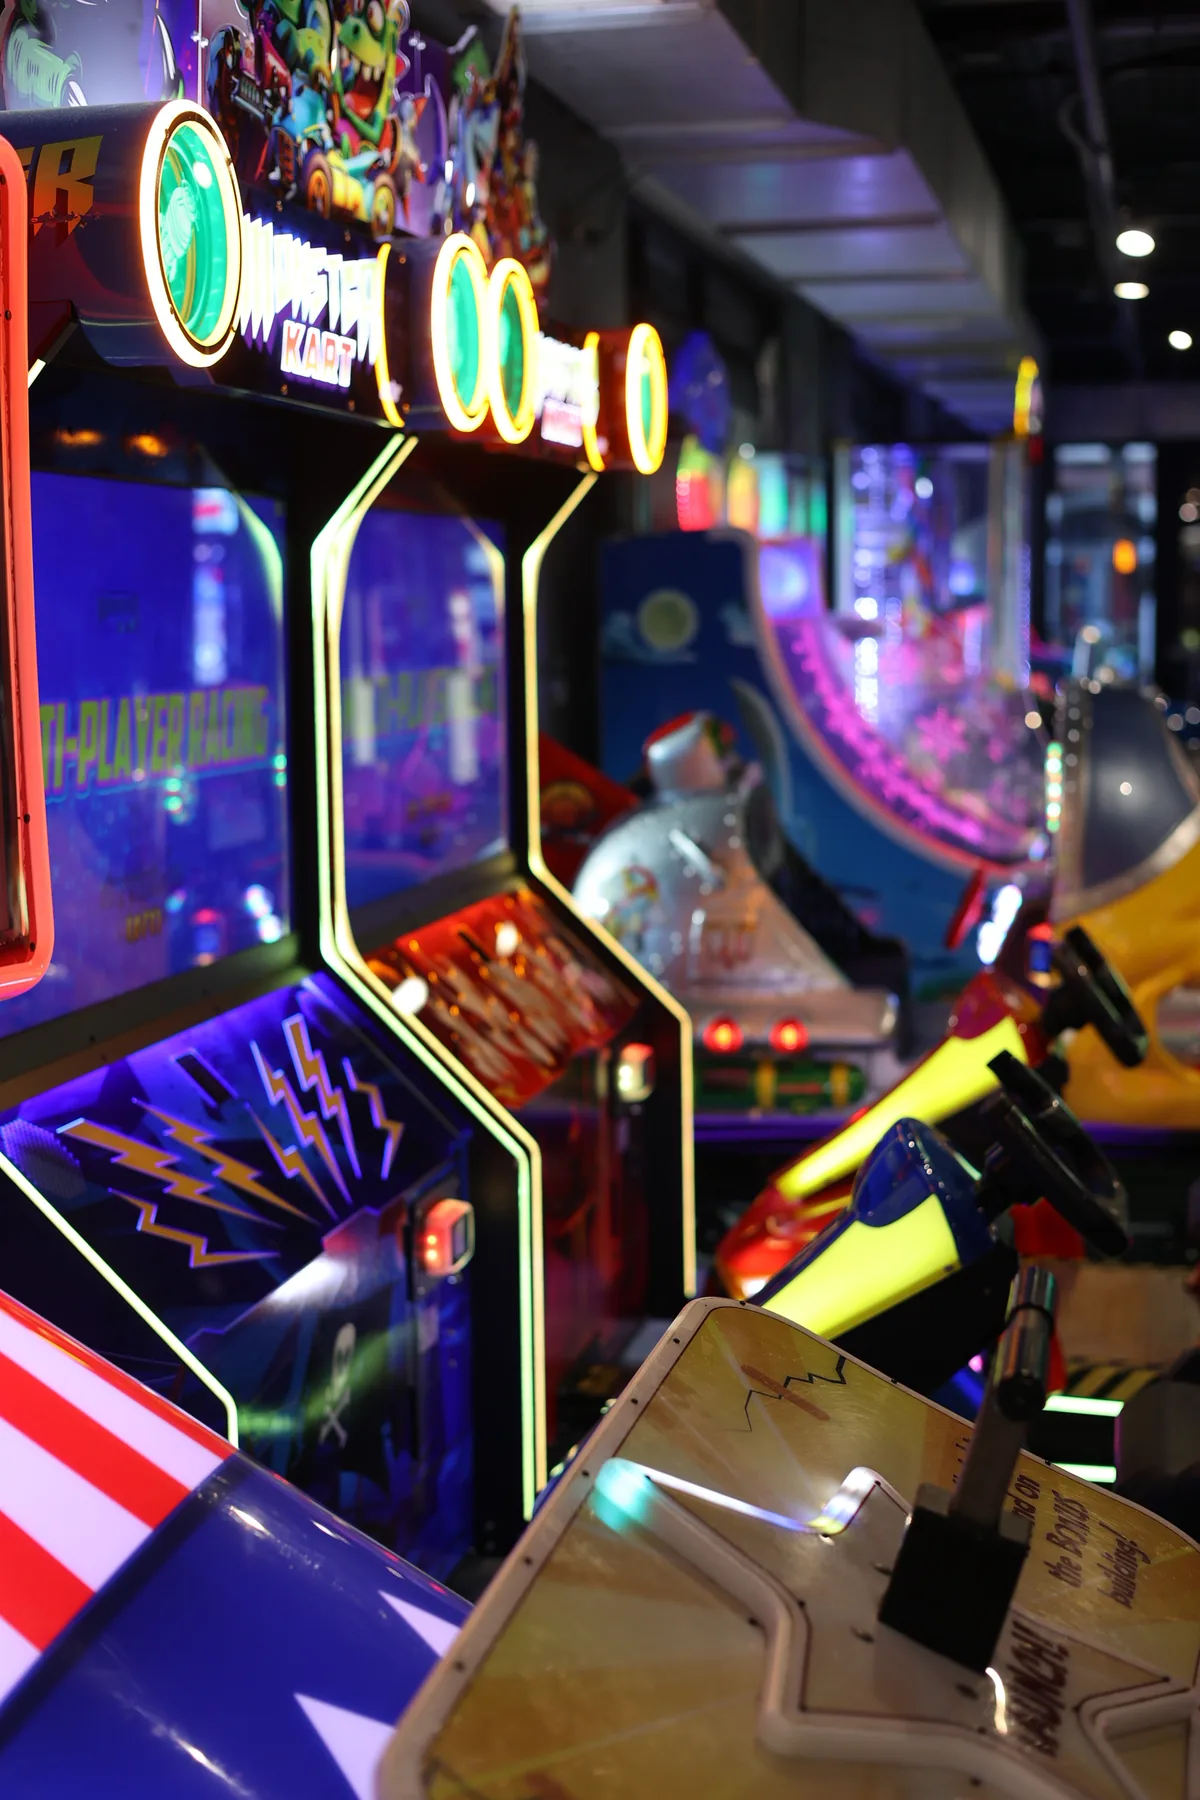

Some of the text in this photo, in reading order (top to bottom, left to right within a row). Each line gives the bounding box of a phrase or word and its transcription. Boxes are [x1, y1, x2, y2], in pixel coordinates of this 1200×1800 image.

[16, 135, 104, 237] R
[280, 319, 357, 388] KART
[186, 685, 269, 767] RACING
[1014, 1474, 1041, 1500] on
[1043, 1555, 1083, 1588] the
[1097, 1520, 1151, 1609] building!
